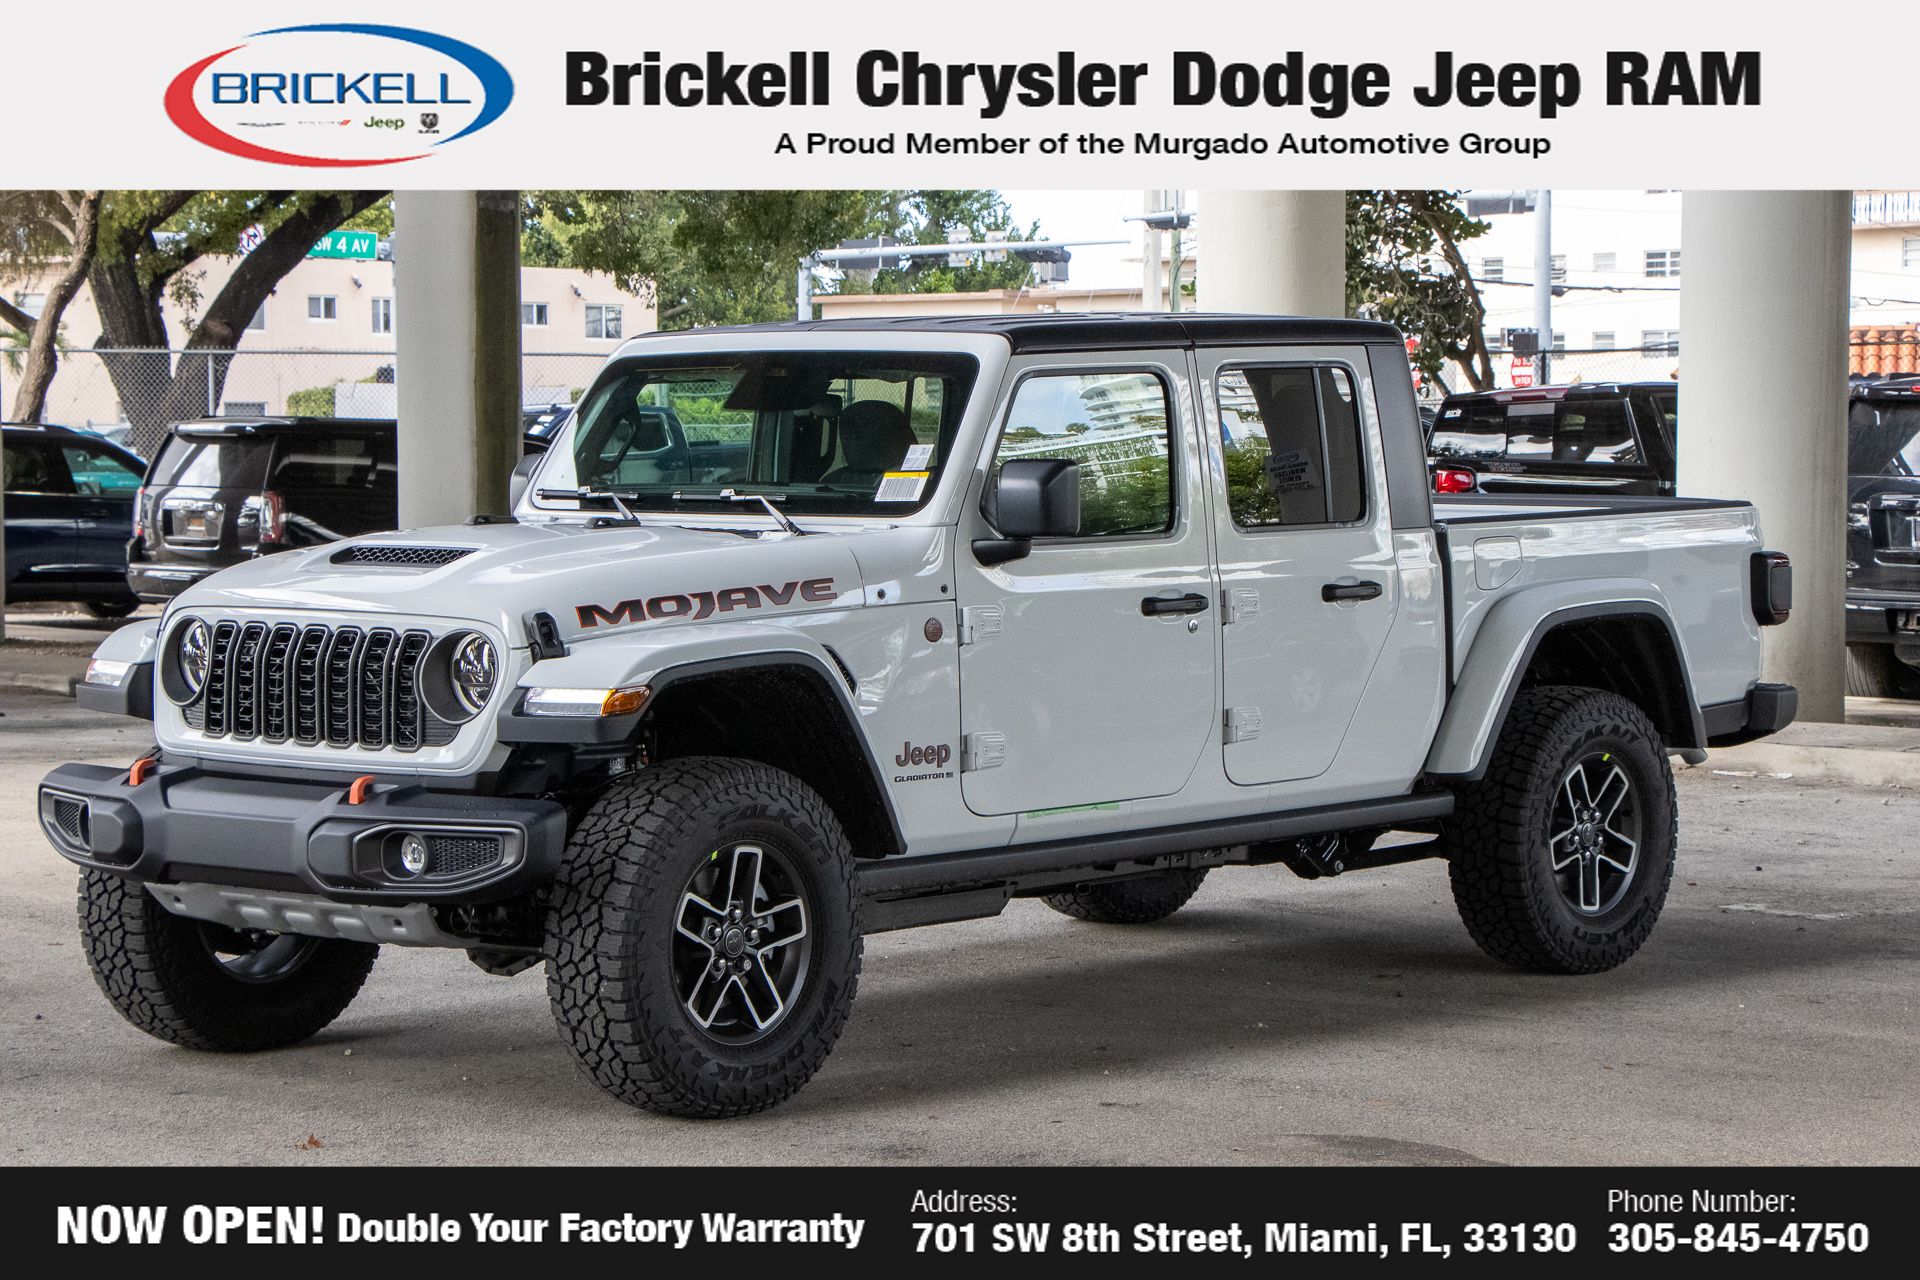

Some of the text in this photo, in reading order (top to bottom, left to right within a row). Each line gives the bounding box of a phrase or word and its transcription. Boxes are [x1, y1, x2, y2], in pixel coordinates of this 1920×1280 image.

[314, 236, 369, 253] SW 4 AV
[575, 577, 838, 629] MOJAVE
[895, 740, 952, 769] Jeep
[894, 771, 945, 783] GLADIATOR
[717, 803, 833, 865] FALKEN
